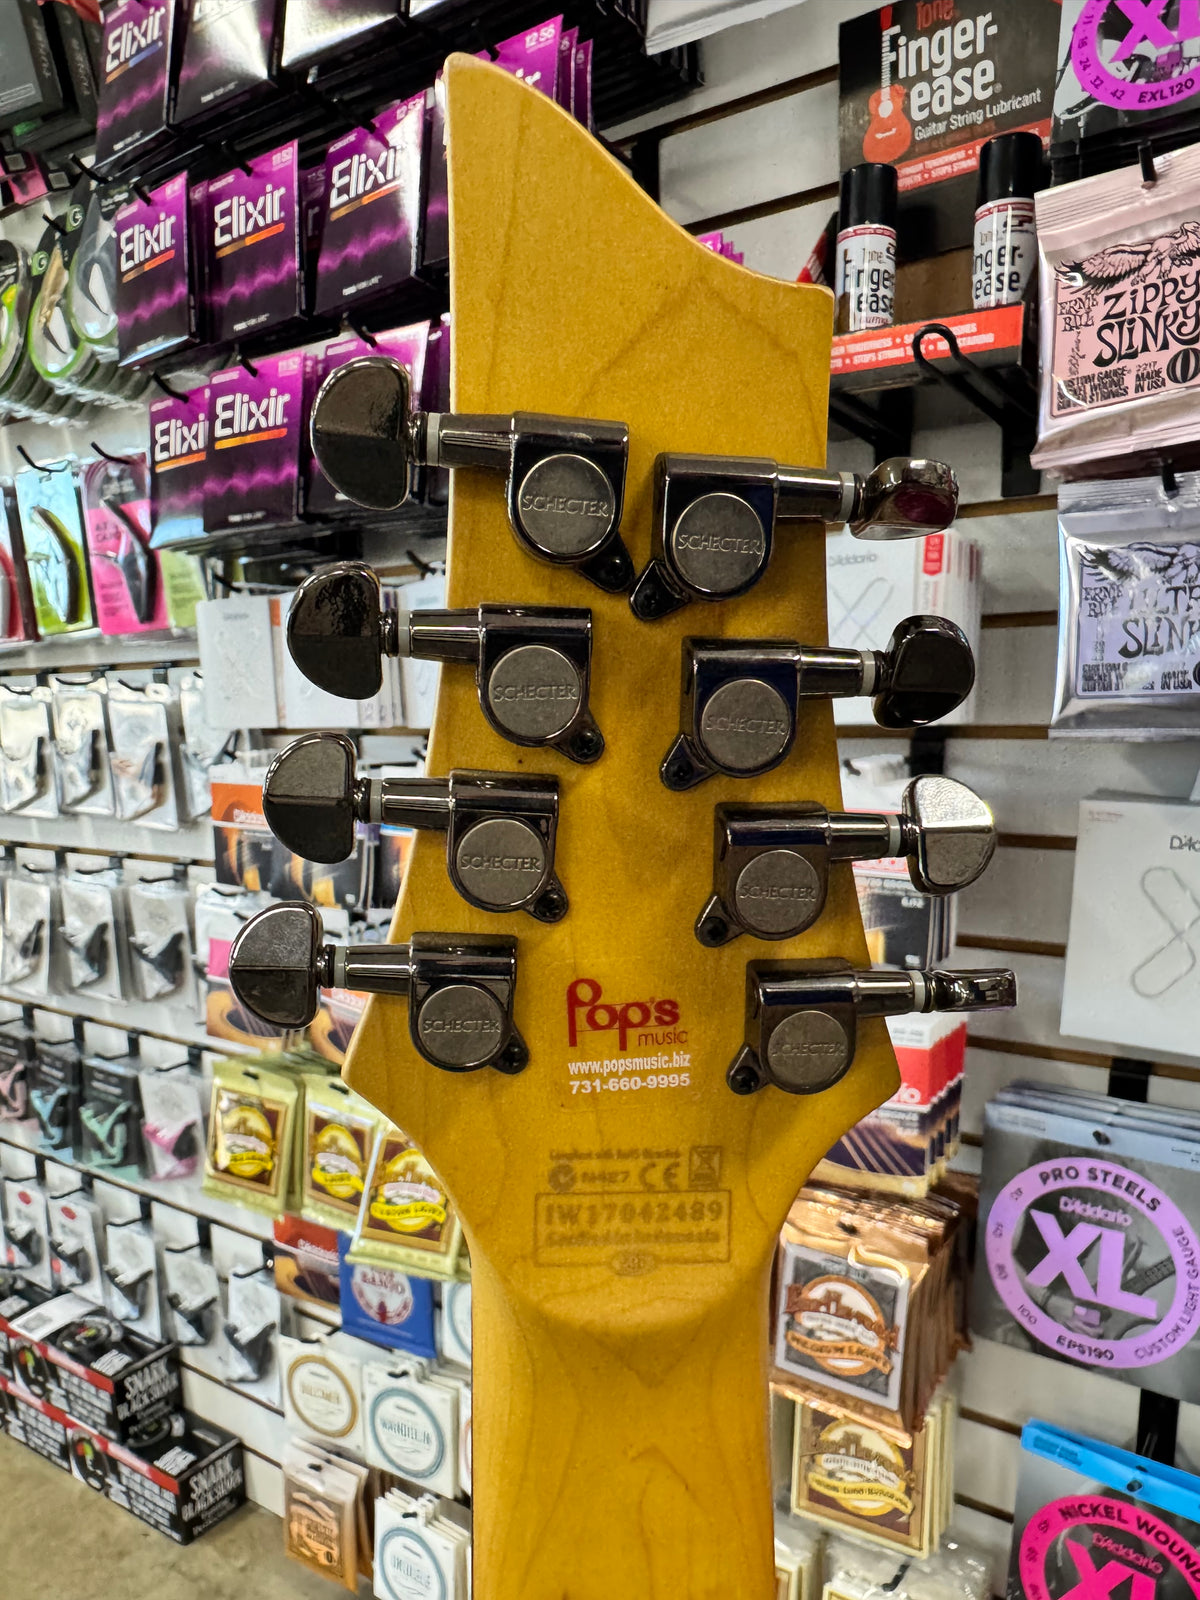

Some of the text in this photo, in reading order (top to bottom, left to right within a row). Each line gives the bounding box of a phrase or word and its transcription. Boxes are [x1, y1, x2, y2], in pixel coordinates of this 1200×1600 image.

[105, 6, 165, 73] Elixir
[1137, 77, 1195, 104] EXL120
[914, 87, 1042, 141] Guitar String Lubricant
[330, 146, 405, 209] Elixi
[214, 184, 285, 248] Elixir
[120, 212, 176, 272] Elixir
[214, 387, 291, 438] Elixir
[154, 412, 209, 462] Elixi
[521, 495, 609, 517] SCHECTER
[677, 534, 764, 555] SCHECTER
[493, 683, 578, 701] SCHECTER
[706, 714, 787, 735] SCHECTER
[460, 855, 542, 873] SCHECTER
[739, 884, 817, 902] SCHECTER
[423, 1018, 502, 1035] SCHECTER
[566, 978, 681, 1051] Pop's
[638, 1025, 689, 1046] music
[770, 1042, 847, 1059] SCHECTER
[568, 1050, 692, 1077] www.popsmusic.biz
[569, 1073, 691, 1095] 731-660-9995
[1039, 1165, 1162, 1213] PRO STEELS
[1059, 1195, 1133, 1228] D'Addario
[1025, 1208, 1158, 1320] XL
[1134, 1322, 1186, 1360] CUSTOM
[1058, 1503, 1129, 1525] NICKEL
[1091, 1532, 1164, 1575] D'Addario
